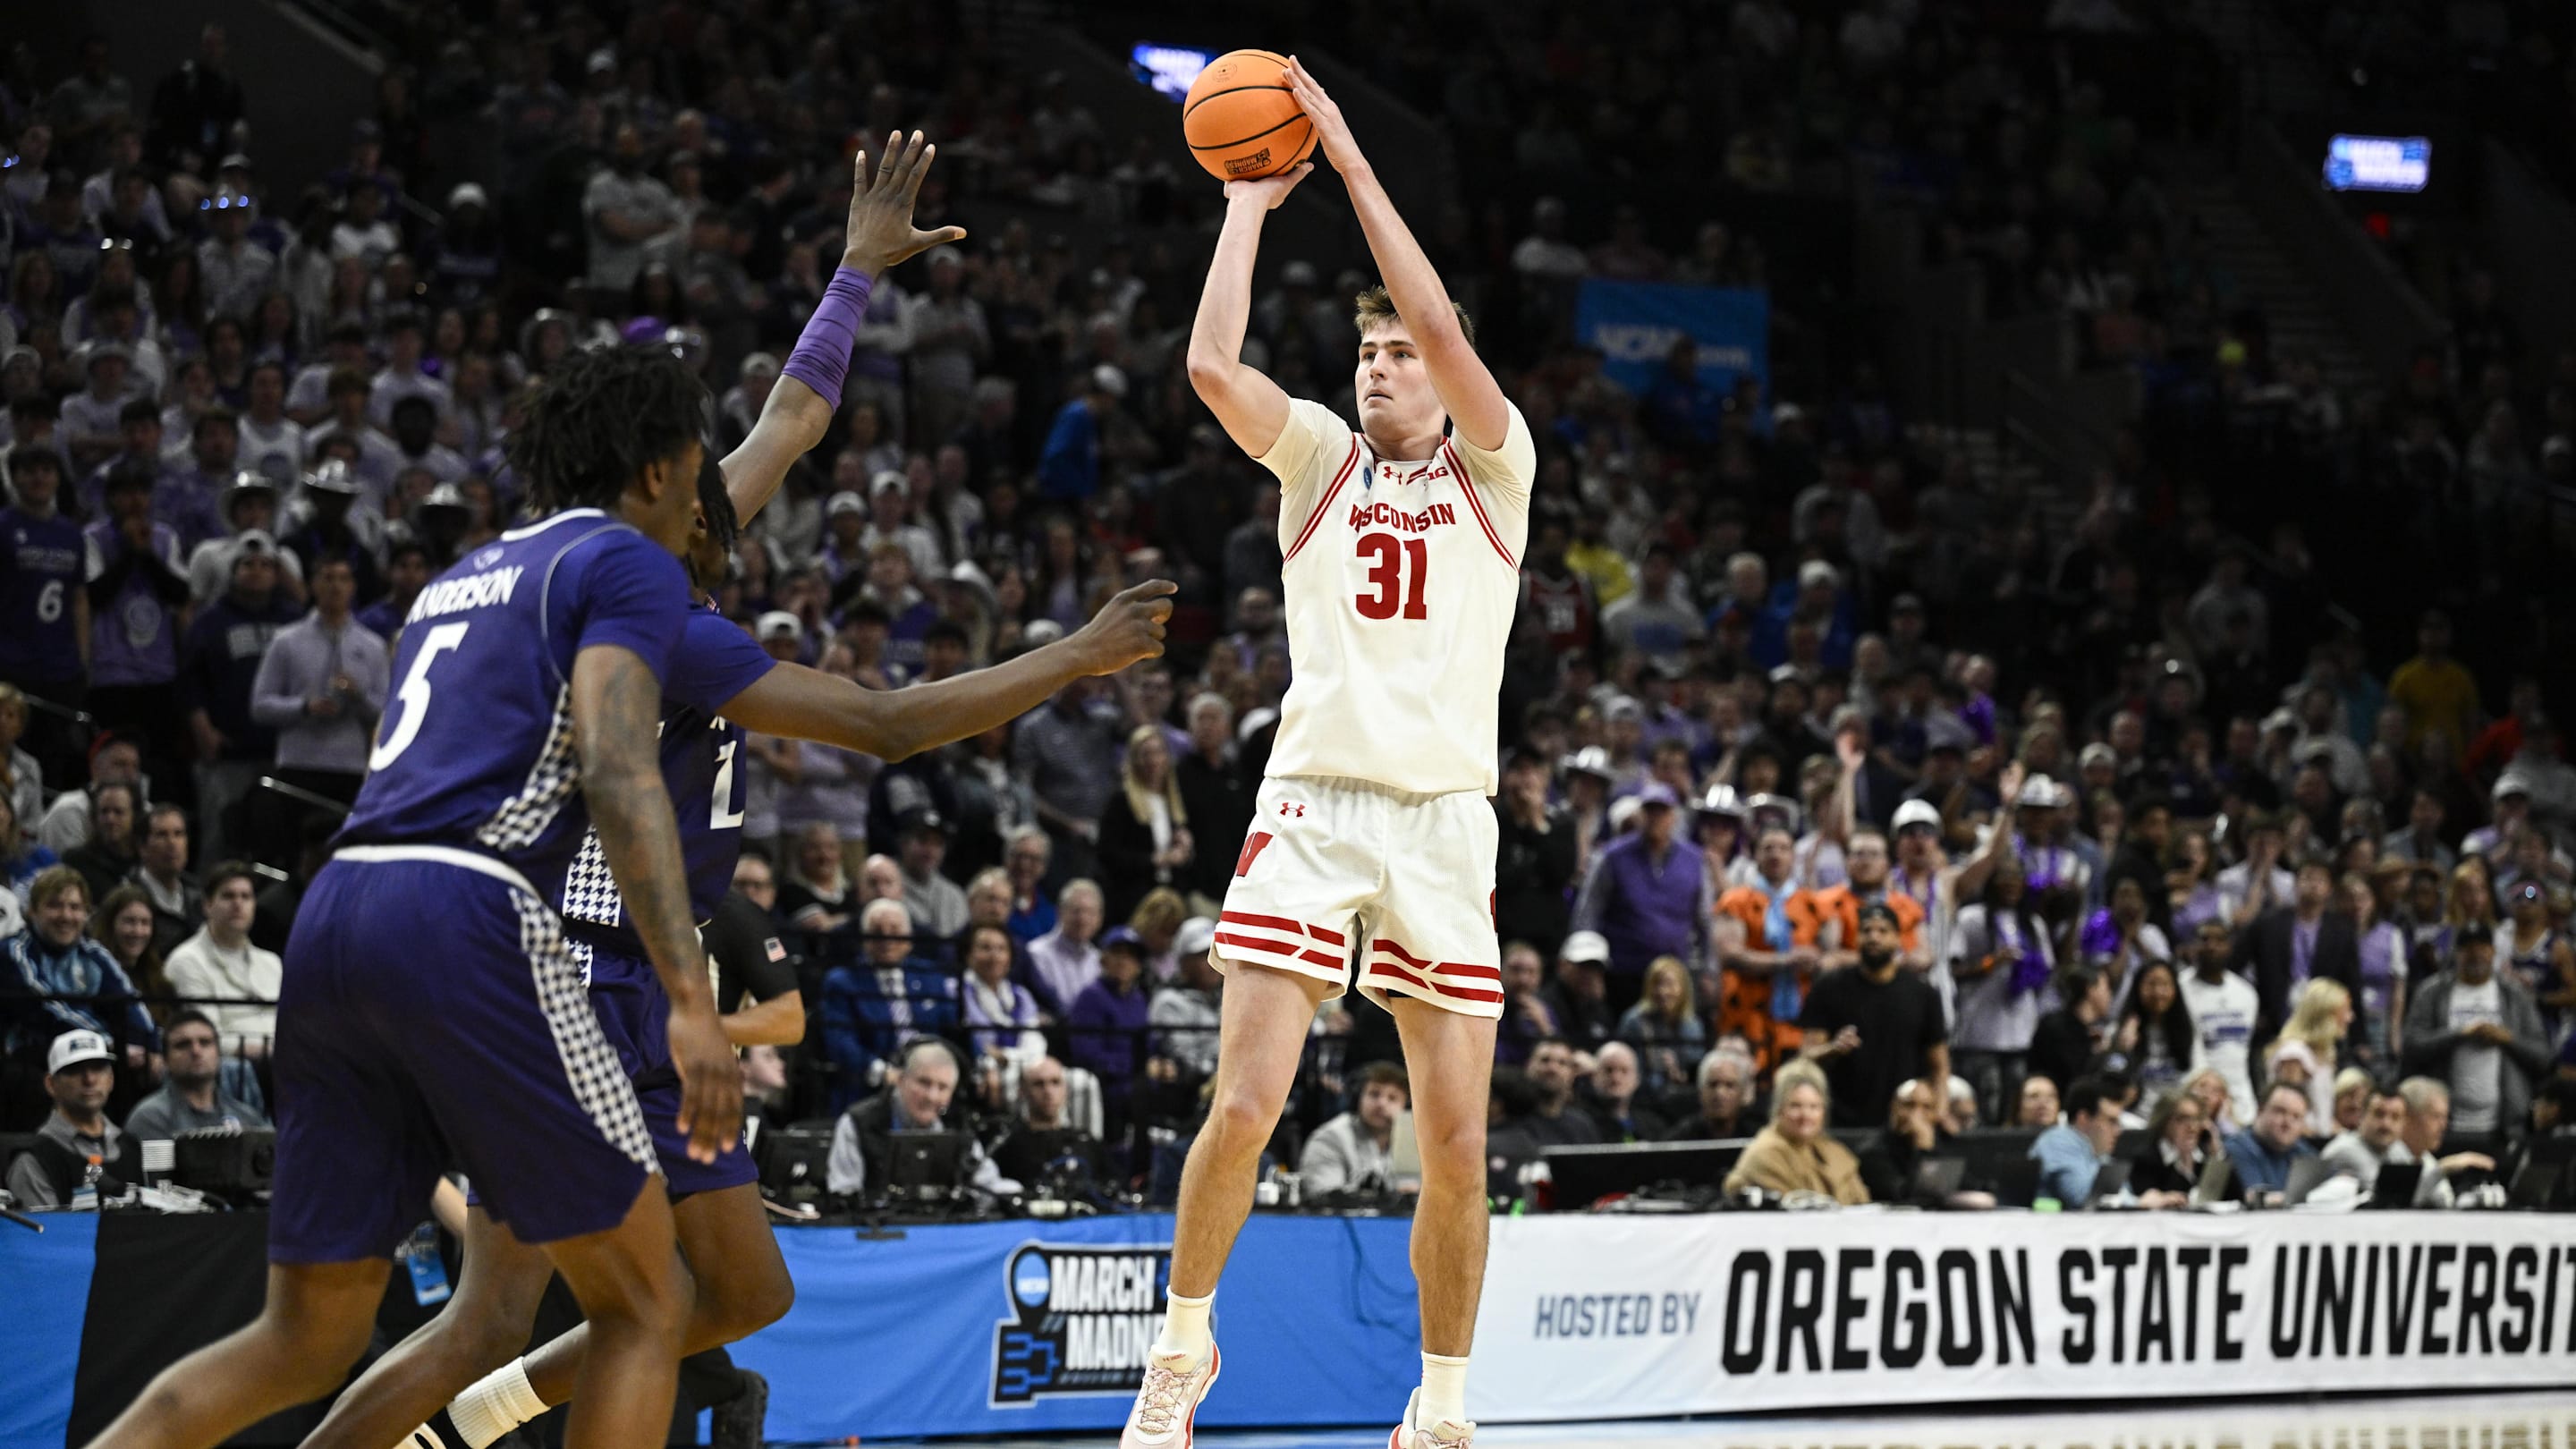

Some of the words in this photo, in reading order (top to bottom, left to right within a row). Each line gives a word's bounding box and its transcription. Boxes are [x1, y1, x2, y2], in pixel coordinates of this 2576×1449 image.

[37, 580, 64, 623] 6
[404, 565, 524, 626] ANDERSON
[1356, 532, 1428, 620] 31
[369, 621, 470, 771] 5
[1048, 1255, 1157, 1312] MARCH
[1534, 1293, 1651, 1338] HOSTED
[1661, 1290, 1701, 1335] BY
[1721, 1247, 2036, 1375] OREGON
[2059, 1245, 2248, 1364] STATE
